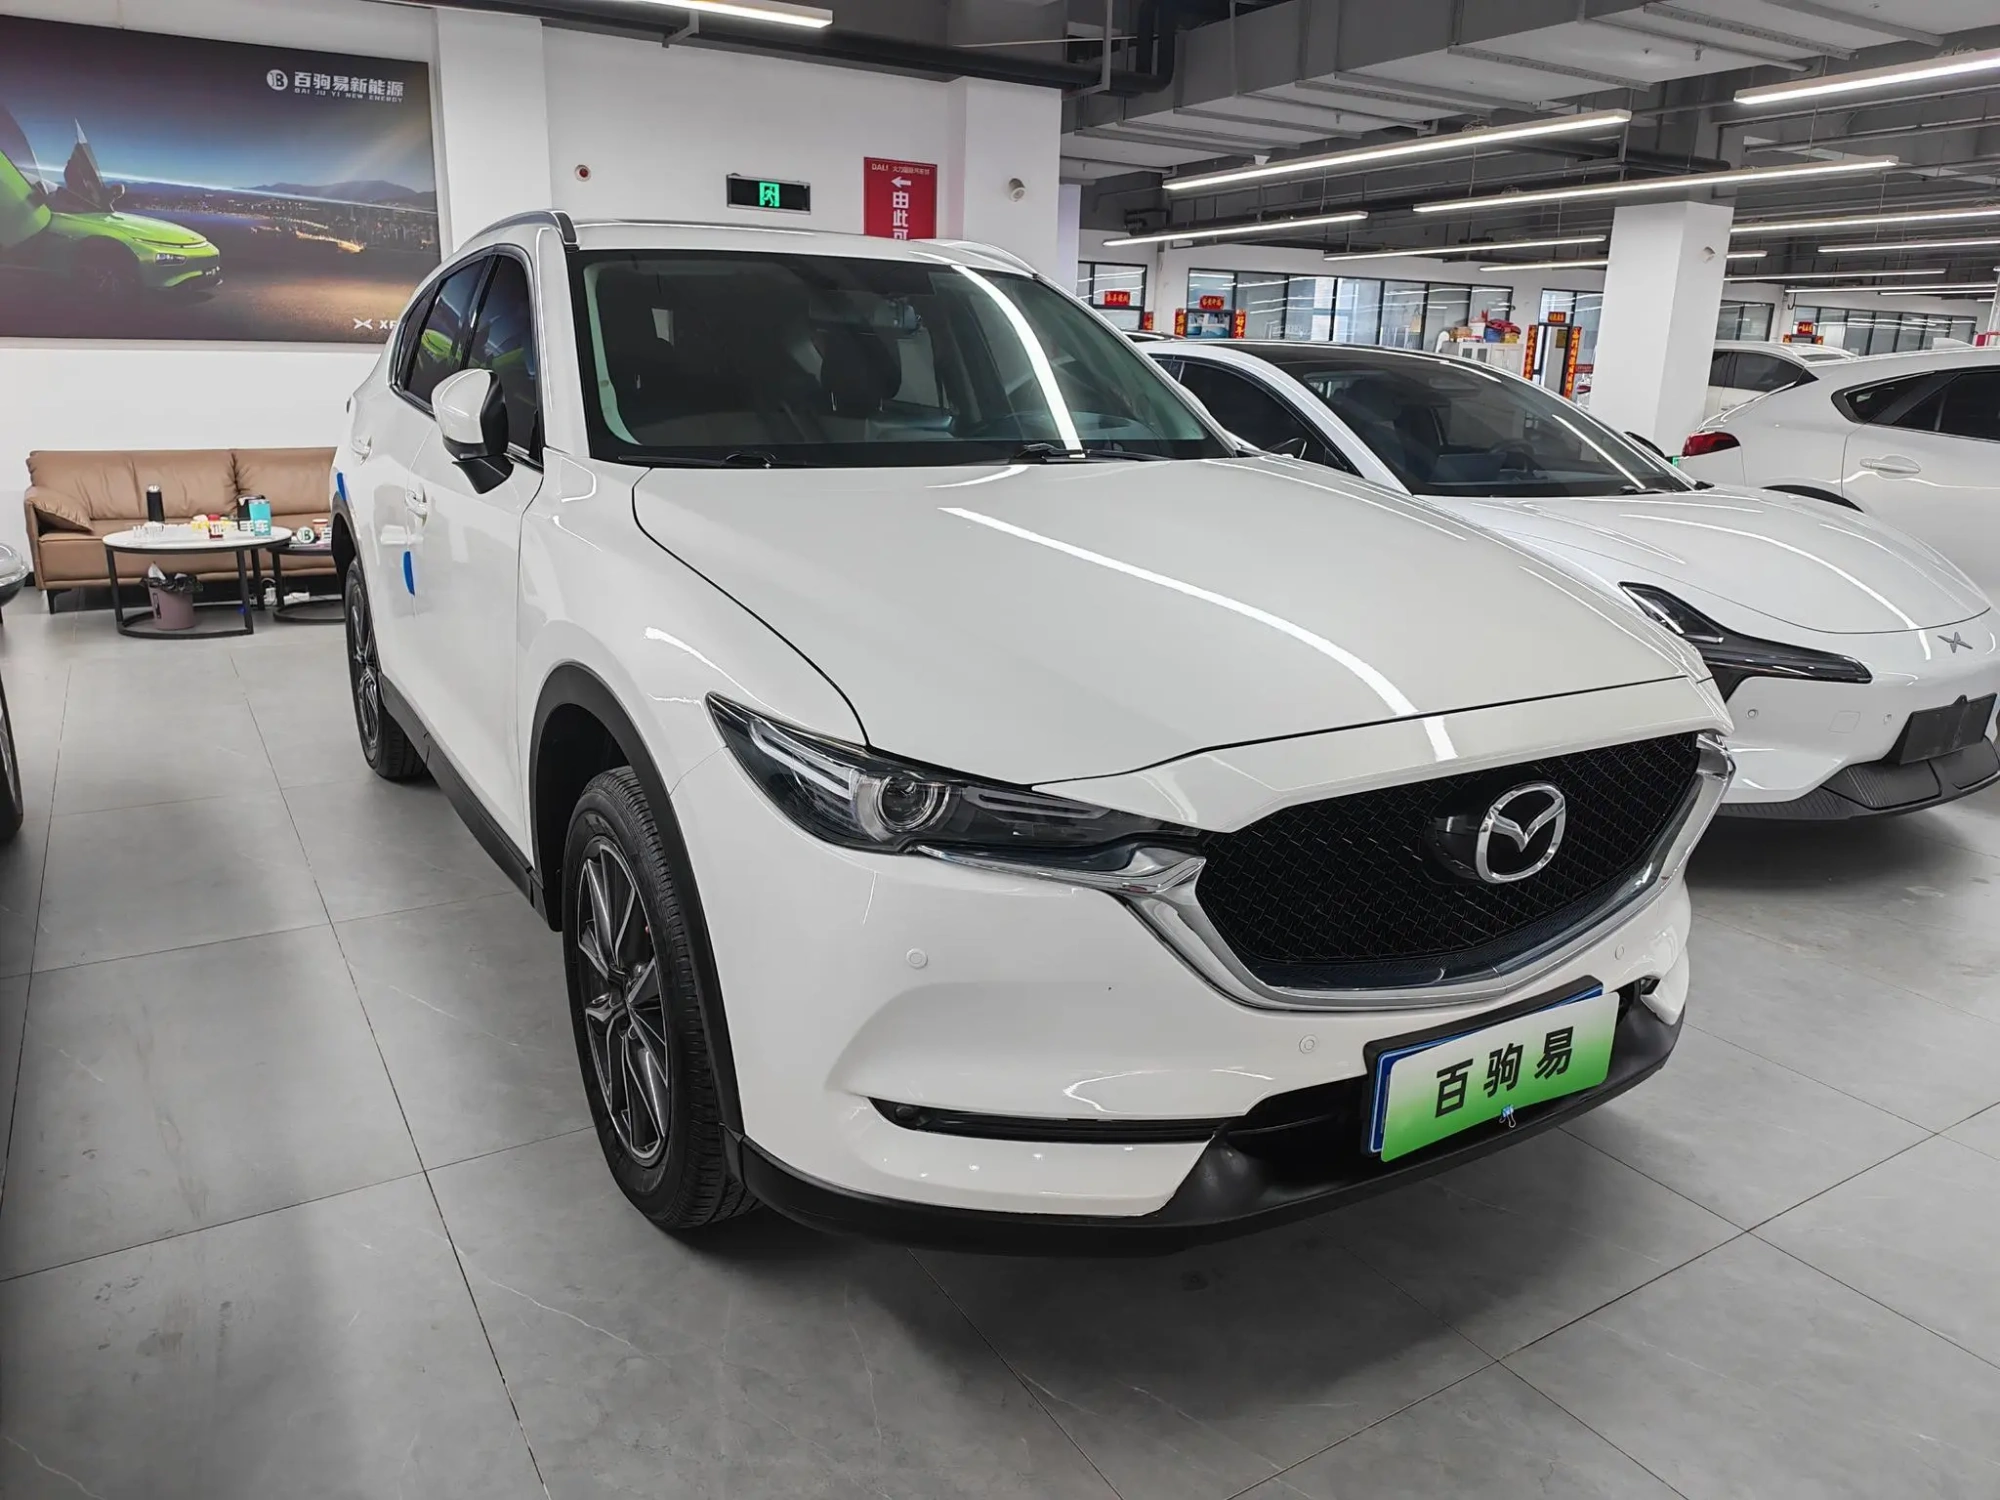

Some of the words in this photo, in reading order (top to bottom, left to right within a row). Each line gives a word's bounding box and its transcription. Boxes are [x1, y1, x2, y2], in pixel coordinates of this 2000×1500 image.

[294, 71, 404, 97] 百驹易新能源
[294, 87, 310, 95] BAI
[369, 94, 403, 103] ENERGY
[1435, 1026, 1574, 1118] 百驹易
